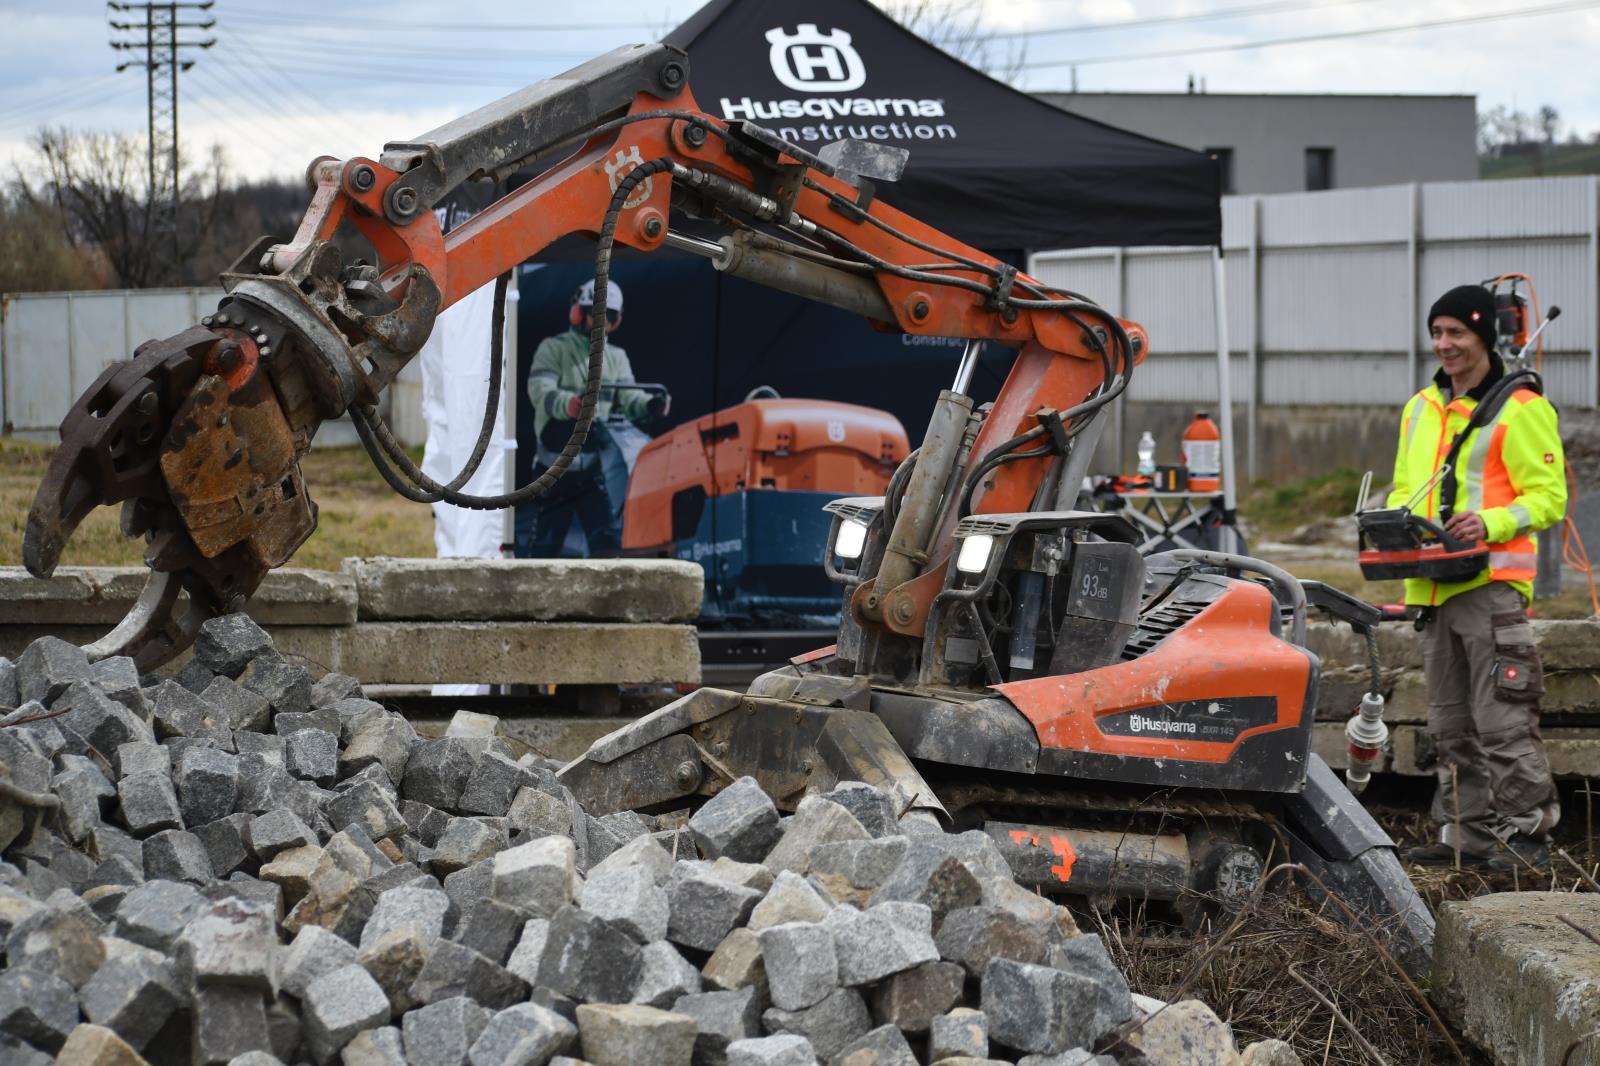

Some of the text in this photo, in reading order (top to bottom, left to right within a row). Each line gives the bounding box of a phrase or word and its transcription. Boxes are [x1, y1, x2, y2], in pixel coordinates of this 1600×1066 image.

[720, 97, 945, 119] Husqvarna
[764, 121, 957, 142] nstruction
[1141, 717, 1196, 733] Husqvarna
